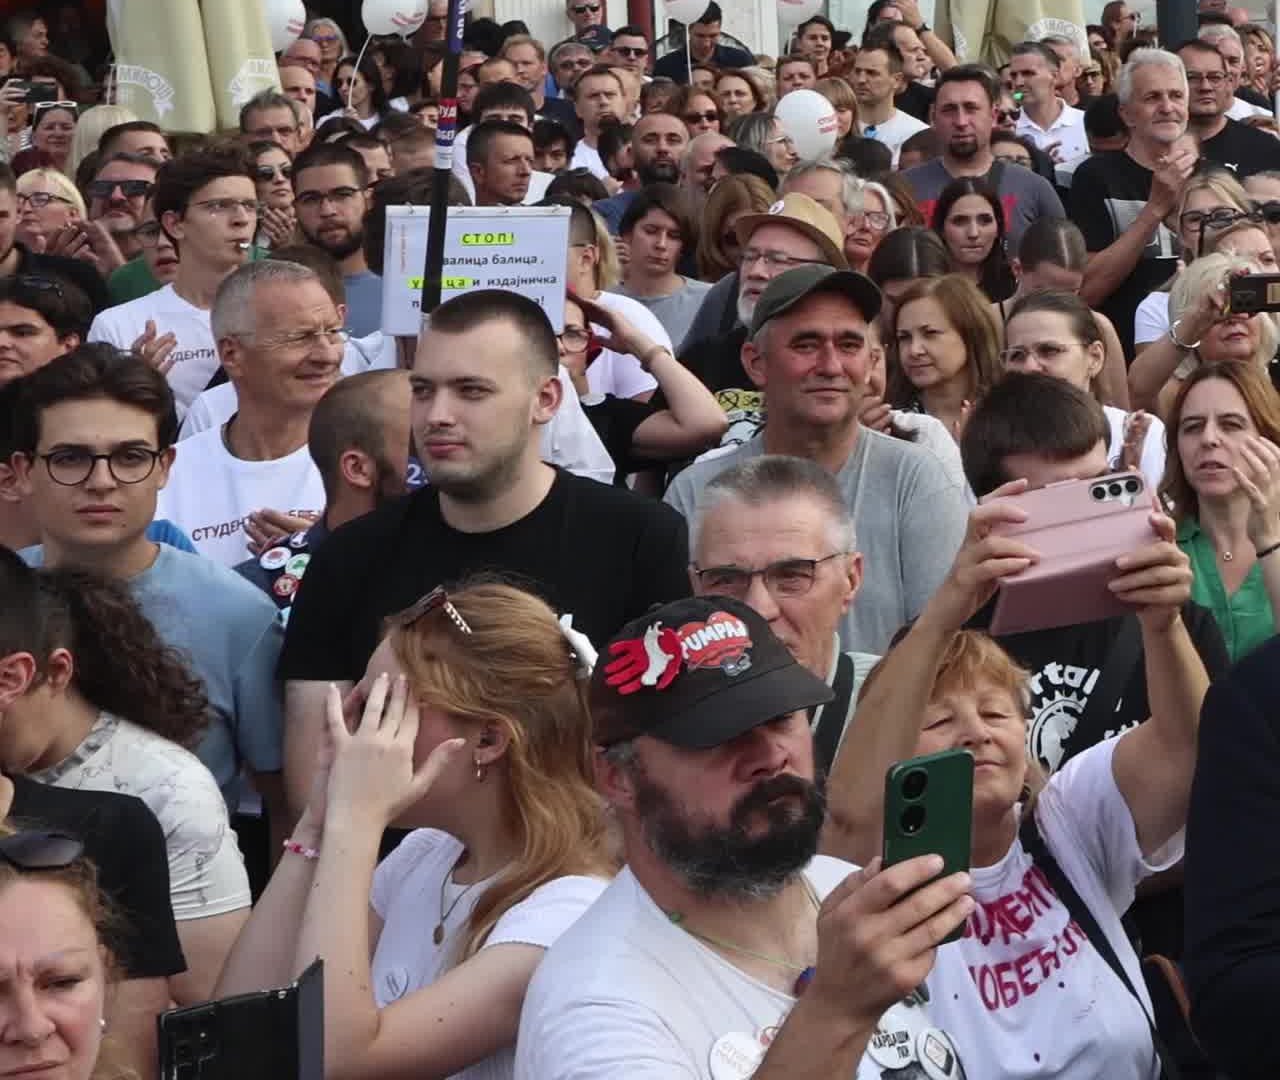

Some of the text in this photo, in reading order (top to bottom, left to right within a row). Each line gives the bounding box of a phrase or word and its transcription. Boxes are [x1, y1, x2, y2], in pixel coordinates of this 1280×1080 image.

[462, 233, 515, 244] СТОП!
[442, 254, 538, 268] валица балица
[412, 275, 557, 289] уца и издајничка
